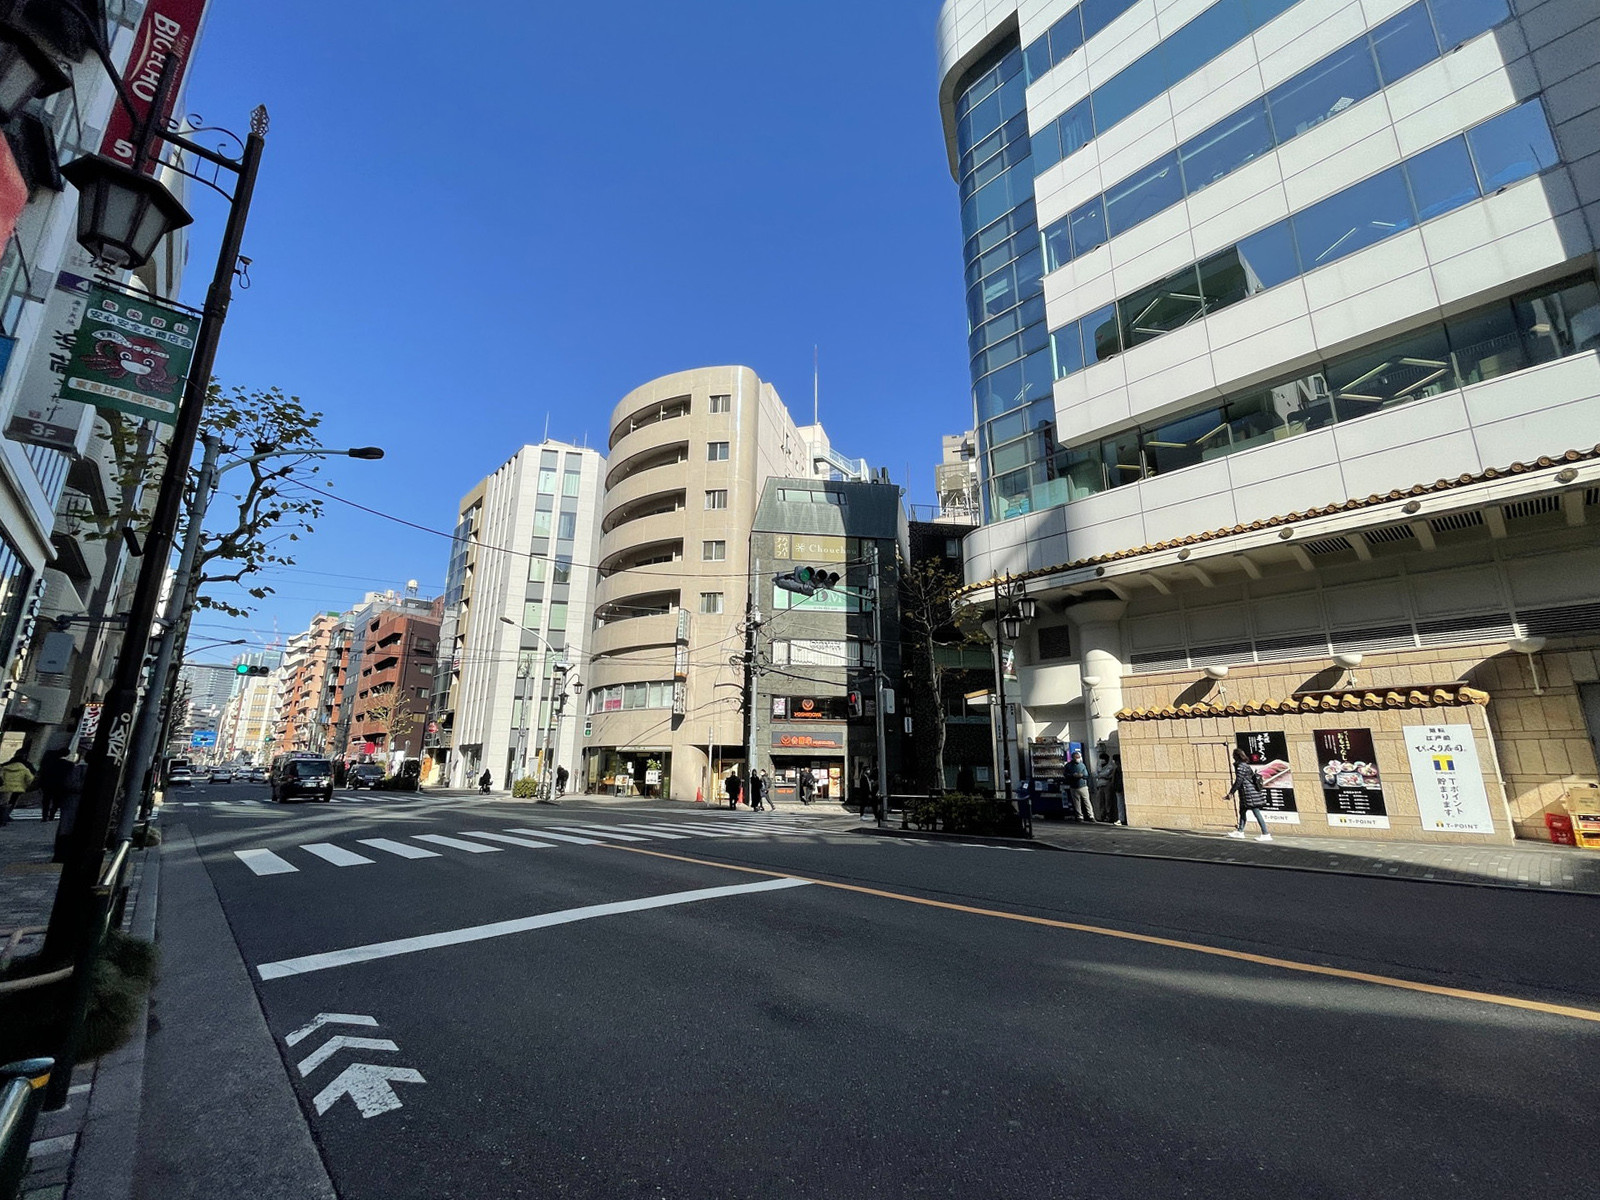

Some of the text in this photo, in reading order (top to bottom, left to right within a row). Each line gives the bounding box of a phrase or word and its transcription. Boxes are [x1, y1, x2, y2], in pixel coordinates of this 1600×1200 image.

[151, 12, 181, 52] BIG
[113, 138, 133, 158] 5
[89, 309, 193, 349] 安心安全な商店会
[30, 423, 57, 438] 3F
[1449, 778, 1464, 815] Tポイント
